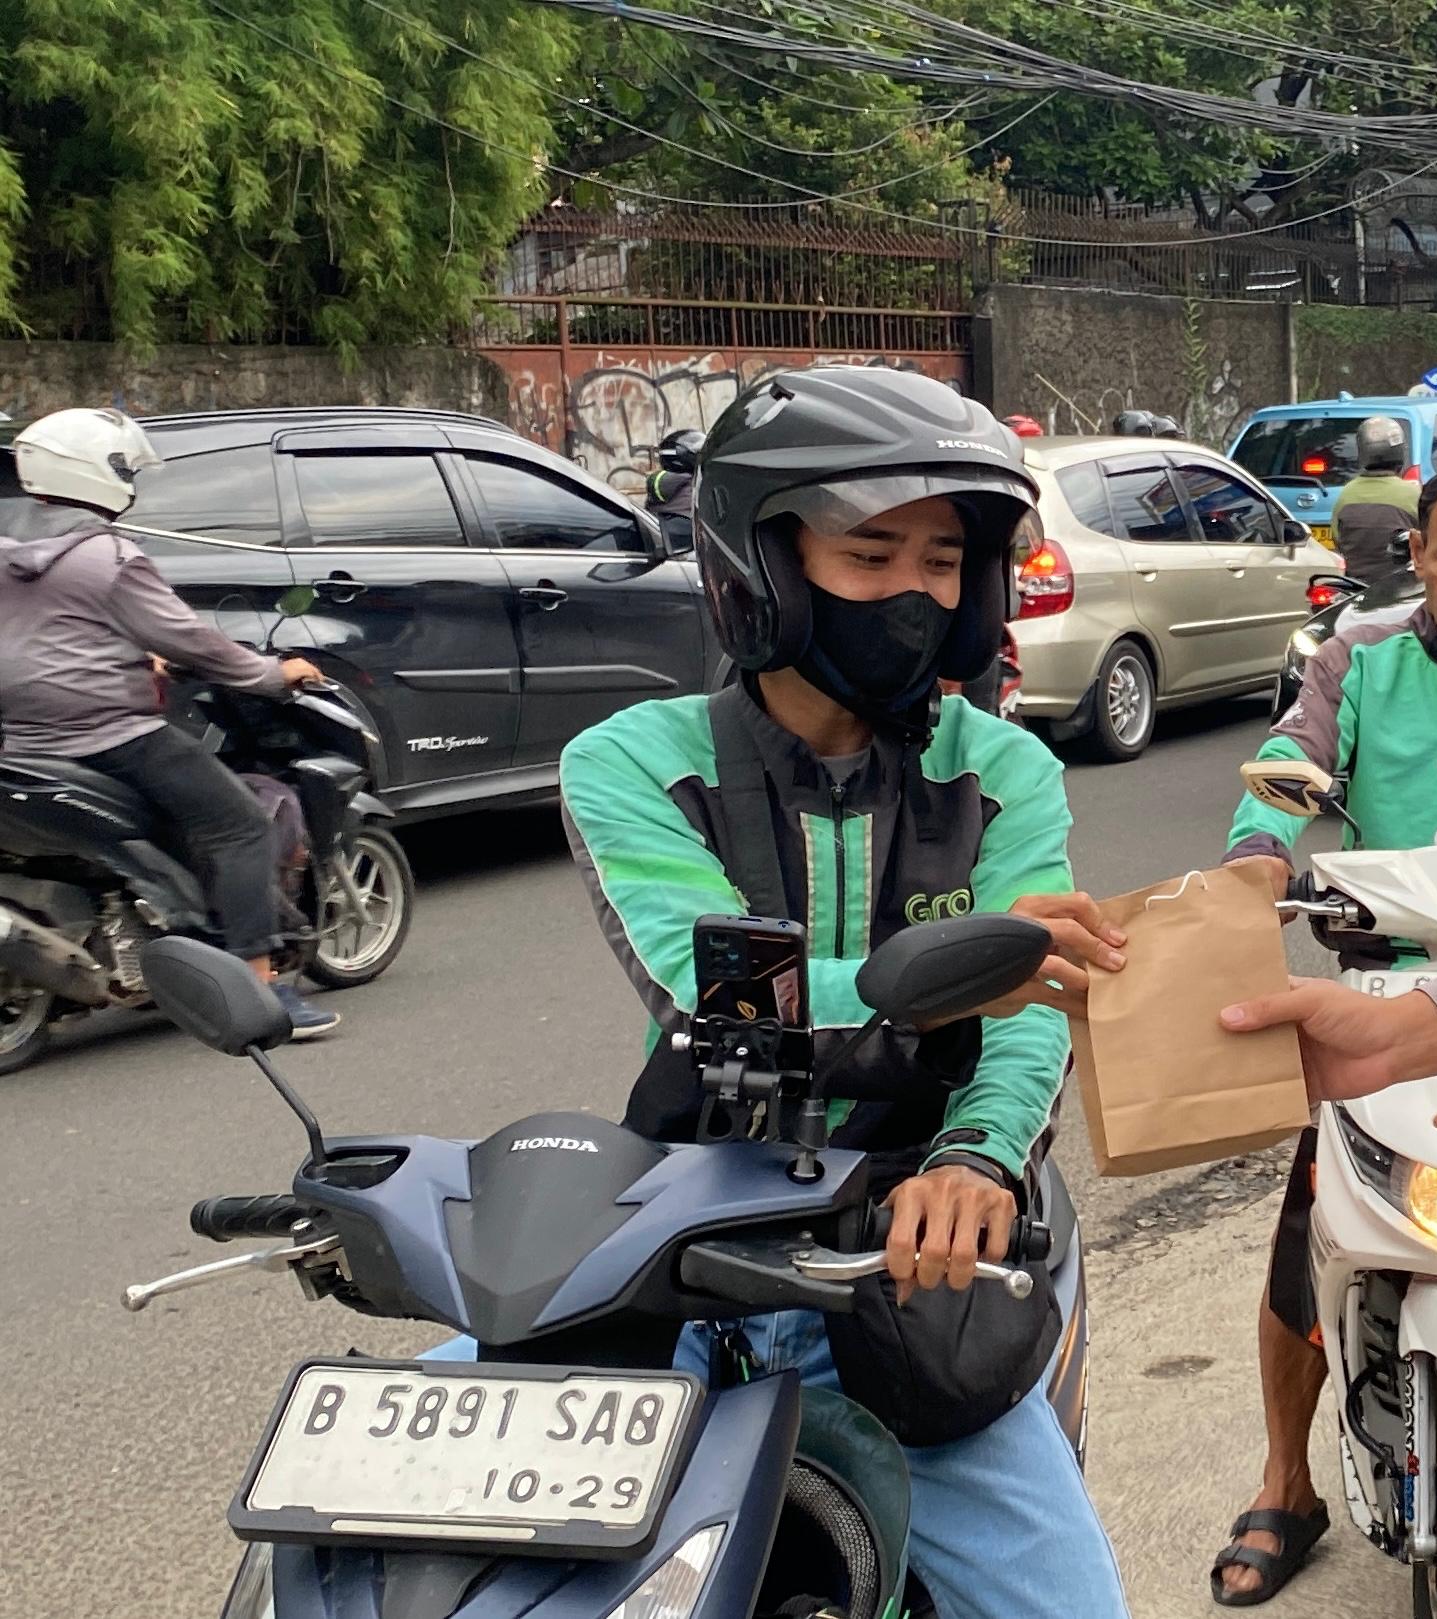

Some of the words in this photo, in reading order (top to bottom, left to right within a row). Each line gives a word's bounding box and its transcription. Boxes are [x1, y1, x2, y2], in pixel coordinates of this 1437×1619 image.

[510, 1137, 599, 1153] HONDA
[303, 1384, 347, 1436] B
[368, 1384, 518, 1441] 5891
